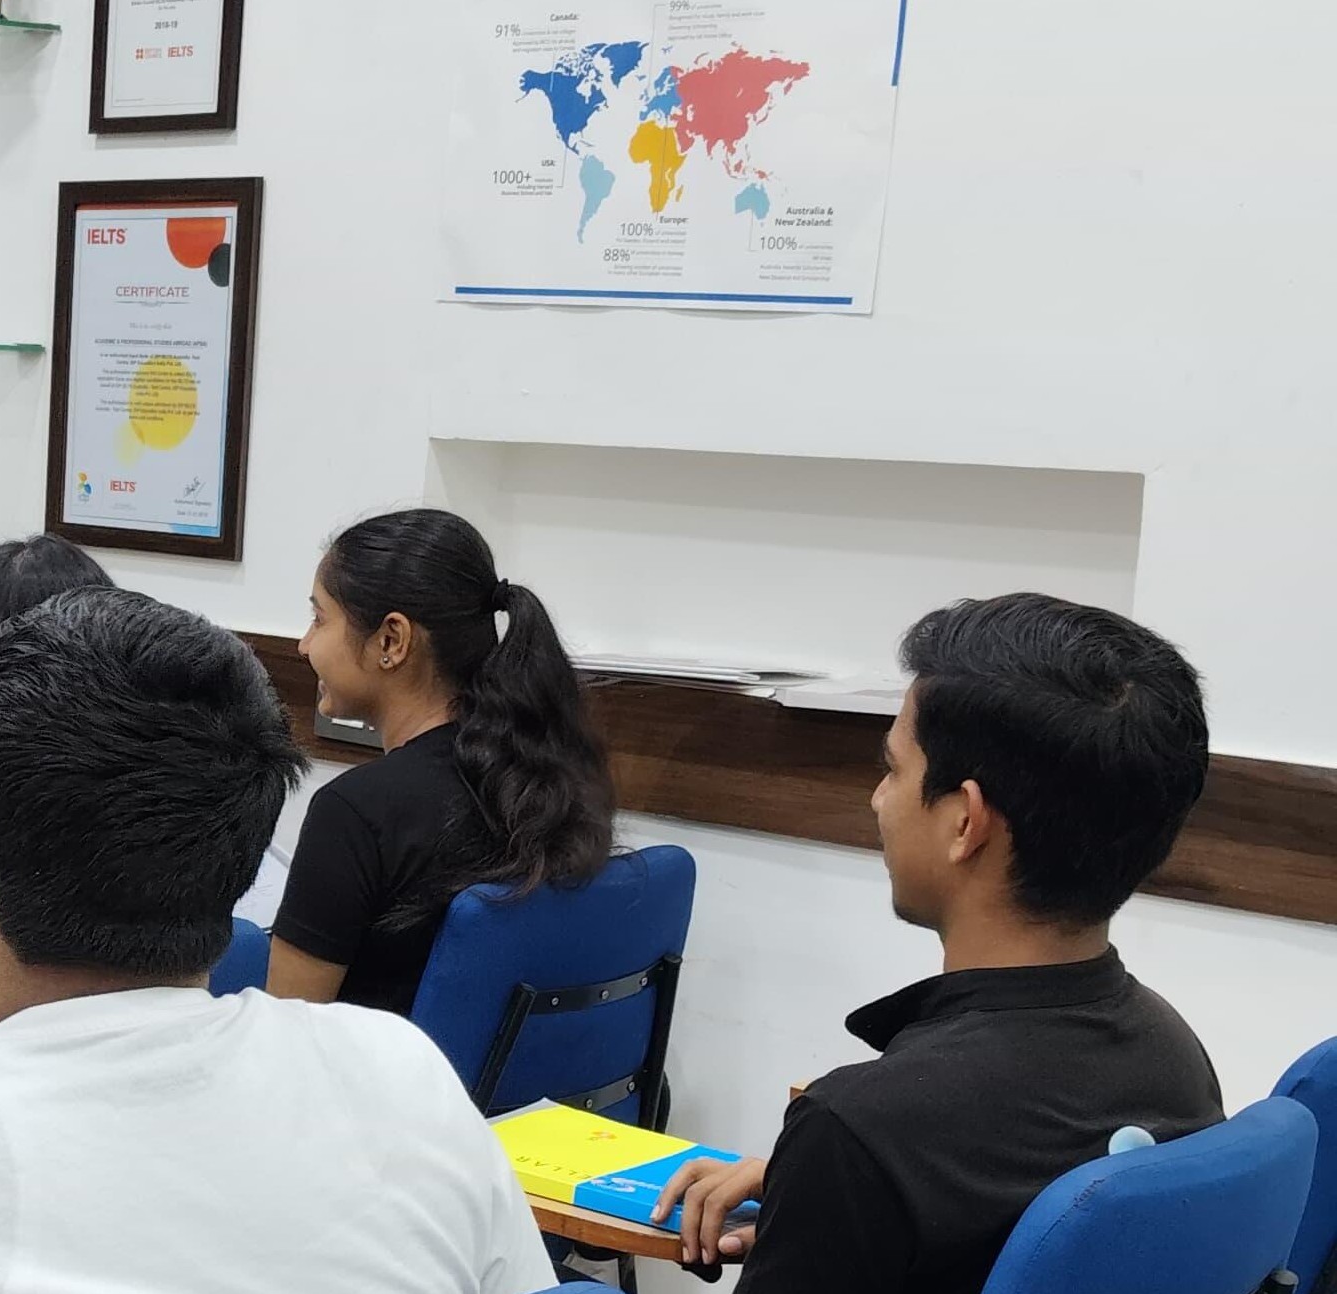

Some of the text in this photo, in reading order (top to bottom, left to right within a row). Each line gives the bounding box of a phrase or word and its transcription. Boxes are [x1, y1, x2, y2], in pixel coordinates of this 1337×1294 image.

[495, 24, 521, 38] 91%
[167, 45, 194, 58] IELTS
[493, 170, 532, 184] 1000+
[786, 206, 834, 215] Australia &
[620, 222, 654, 236] 100%
[775, 218, 795, 226] New
[87, 228, 127, 245] IELTS
[760, 236, 798, 250] 100%
[603, 248, 631, 262] 88%
[115, 286, 190, 298] CERTIFICATE
[109, 480, 136, 492] IELTS
